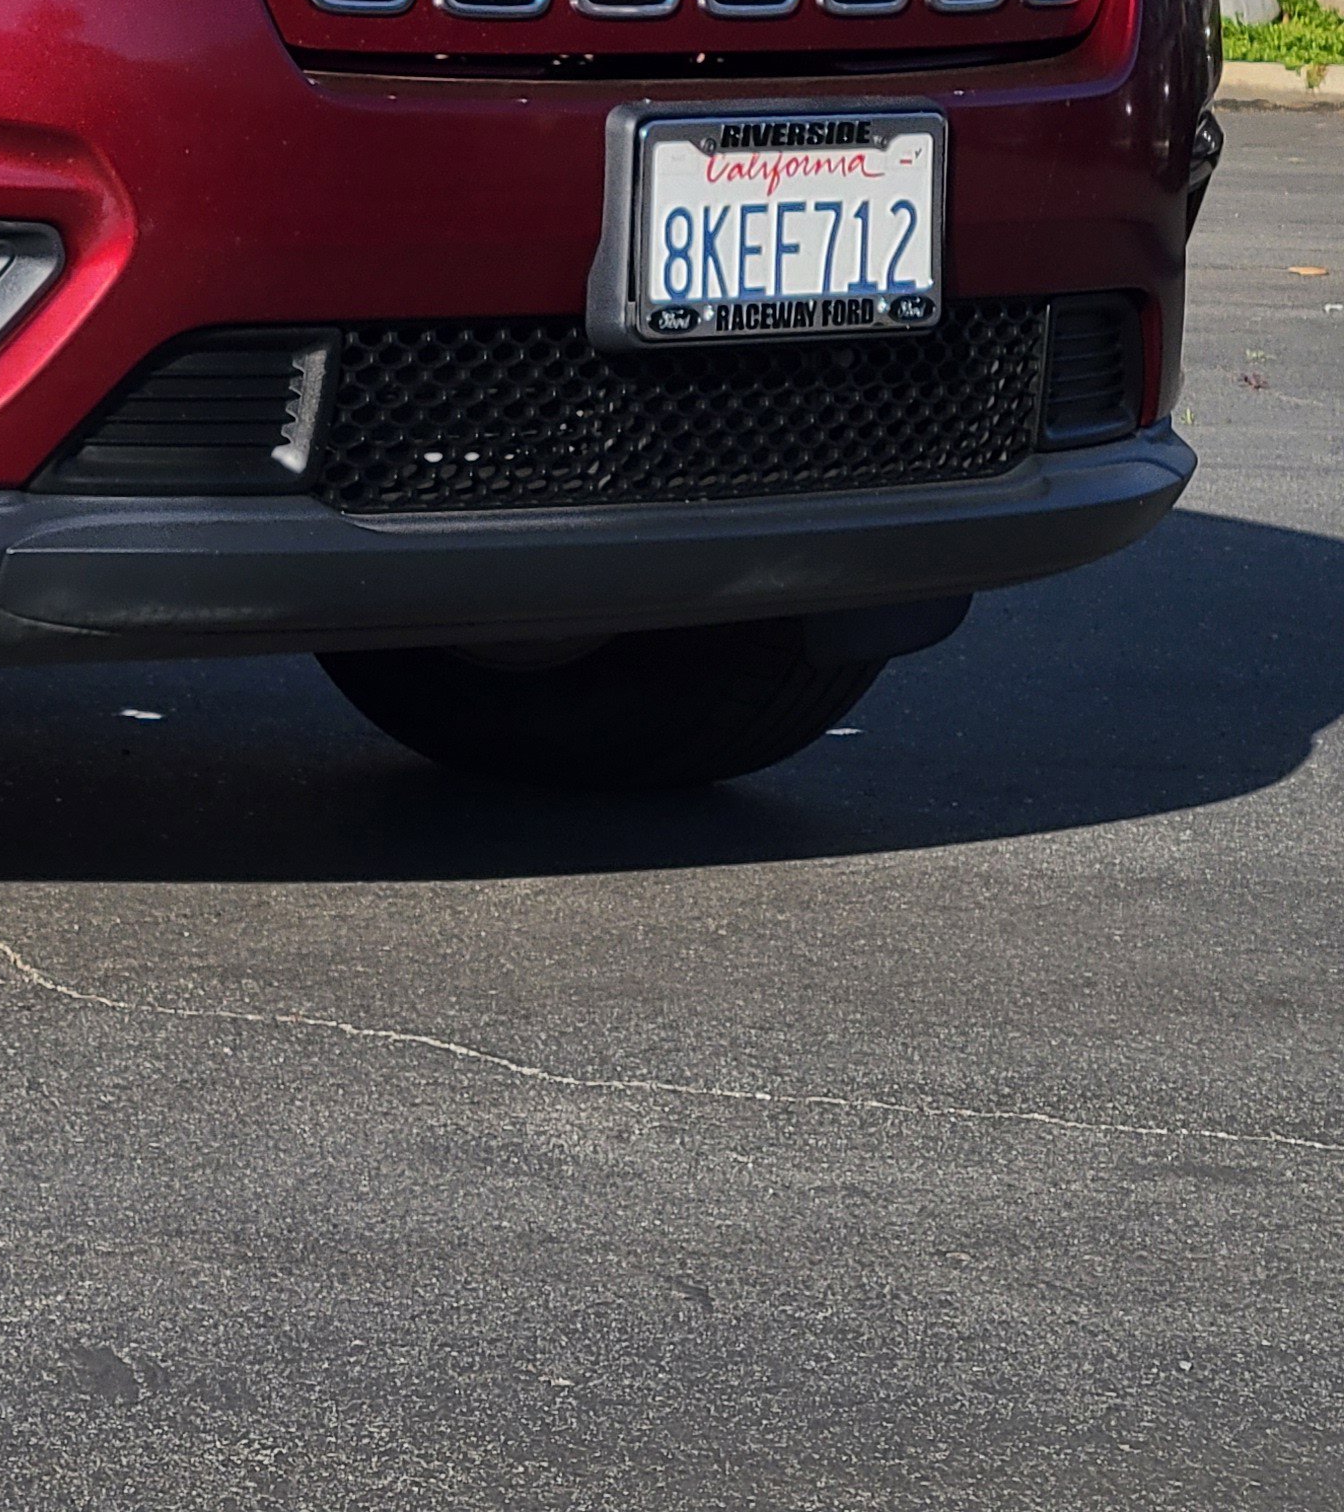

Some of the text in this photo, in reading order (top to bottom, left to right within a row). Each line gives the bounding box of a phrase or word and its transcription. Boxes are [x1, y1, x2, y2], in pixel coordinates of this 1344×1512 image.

[720, 121, 872, 149] RIVERSIDE
[706, 152, 885, 195] California
[664, 200, 918, 300] 8KEF712
[716, 298, 874, 332] RACEWAY FORD
